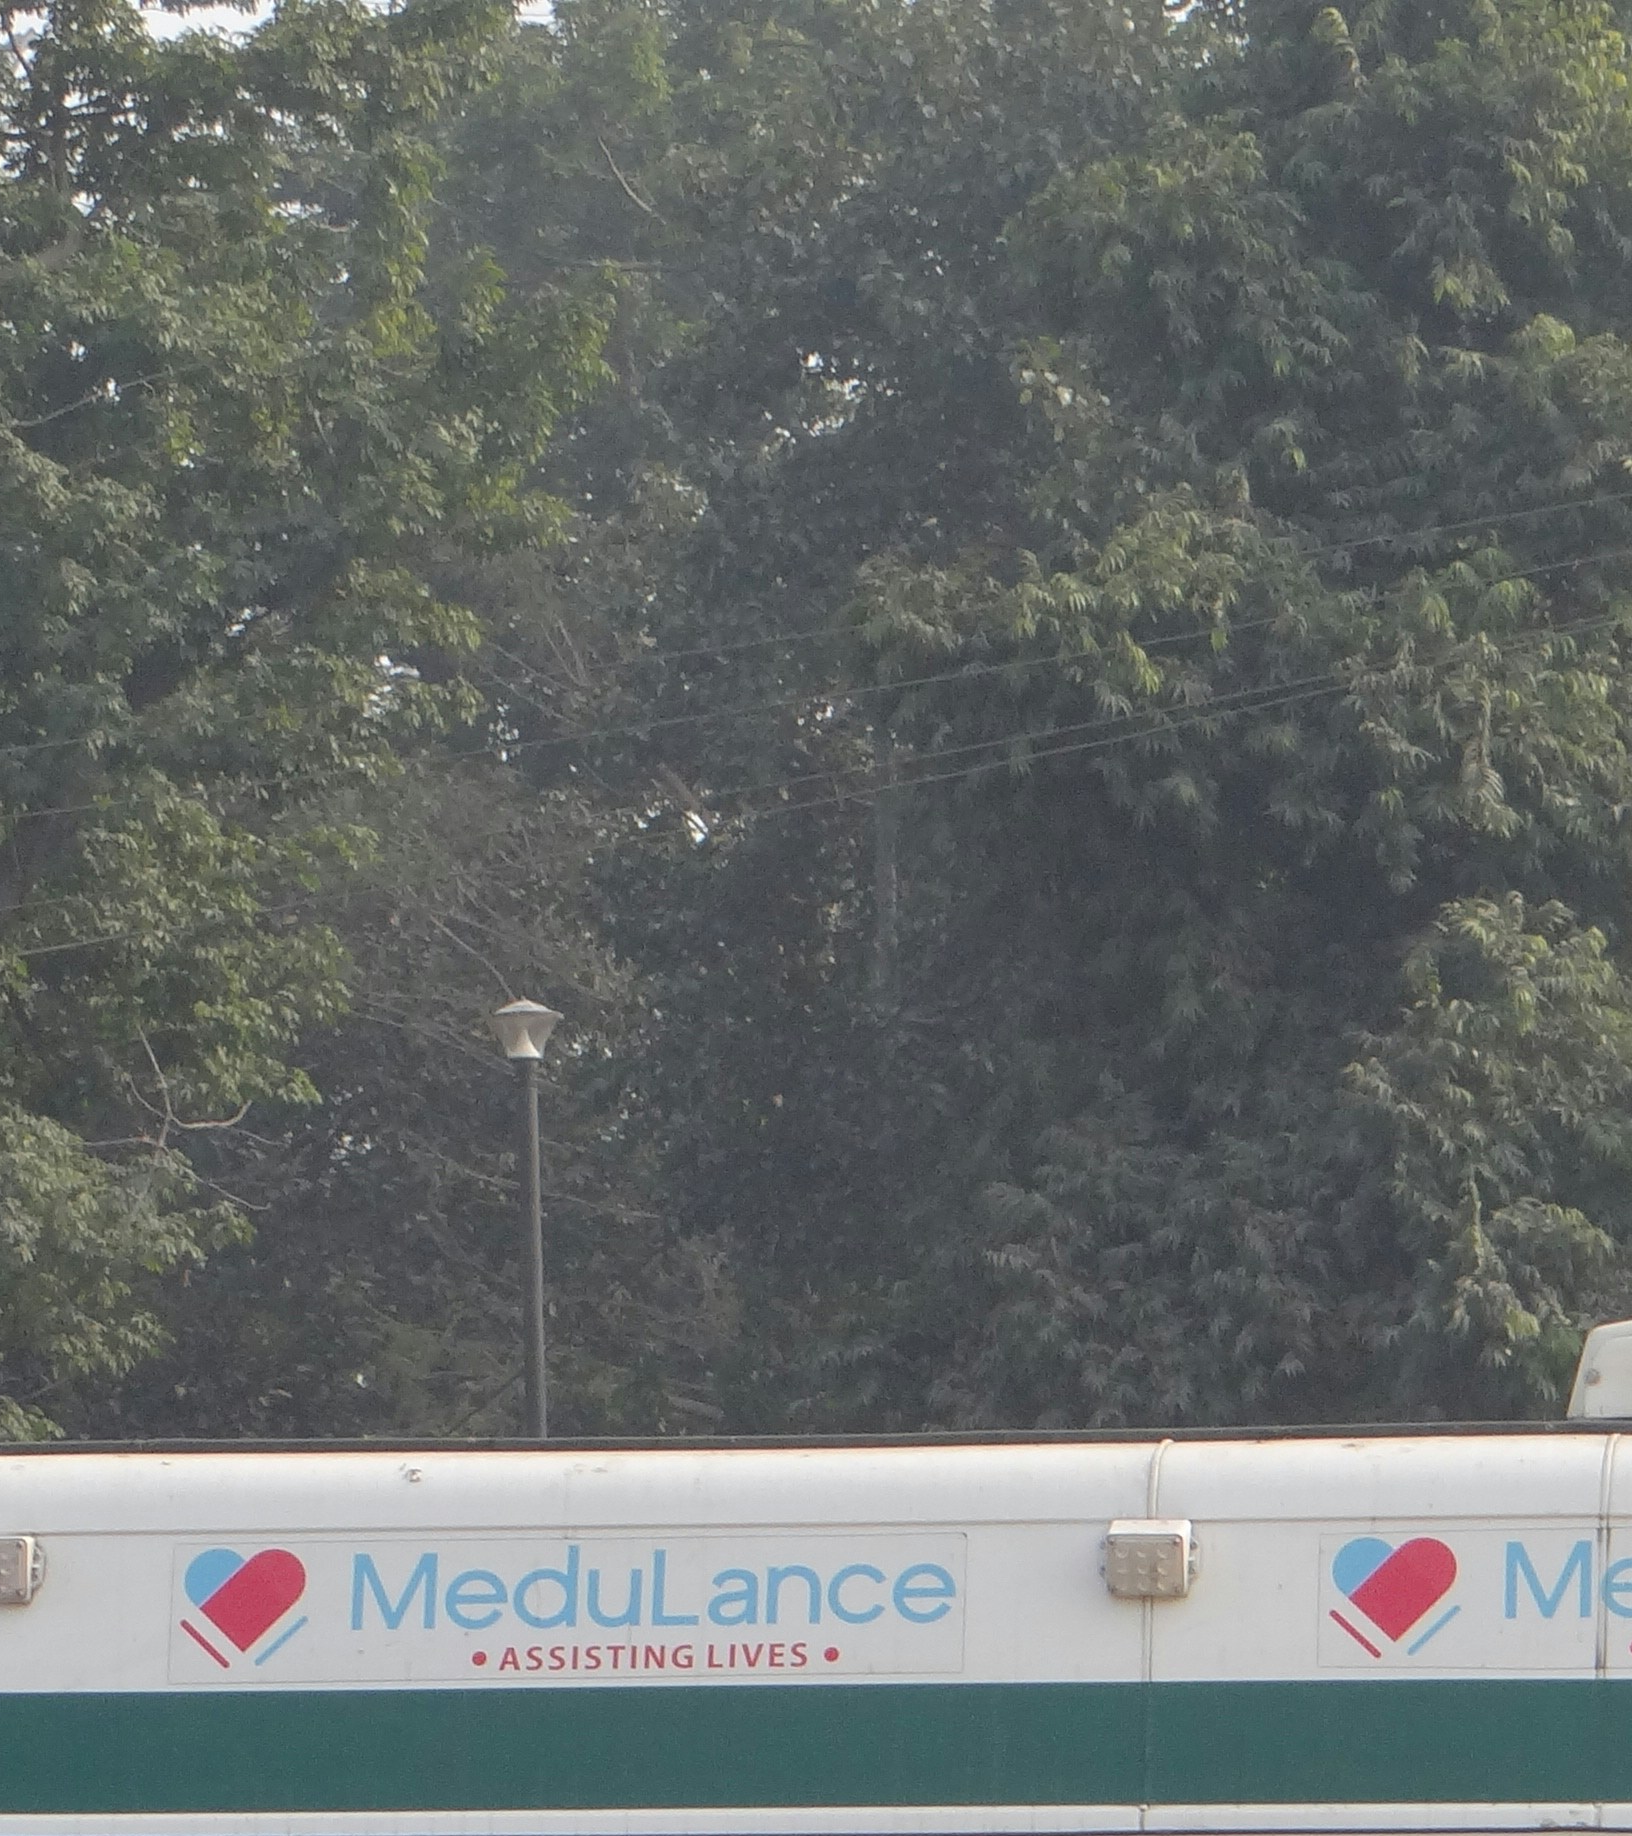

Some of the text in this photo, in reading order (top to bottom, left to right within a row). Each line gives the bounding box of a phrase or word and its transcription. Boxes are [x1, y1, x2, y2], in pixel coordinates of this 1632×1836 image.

[349, 1544, 957, 1631] MeduLance
[499, 1642, 808, 1672] ASSISTING LIVES
